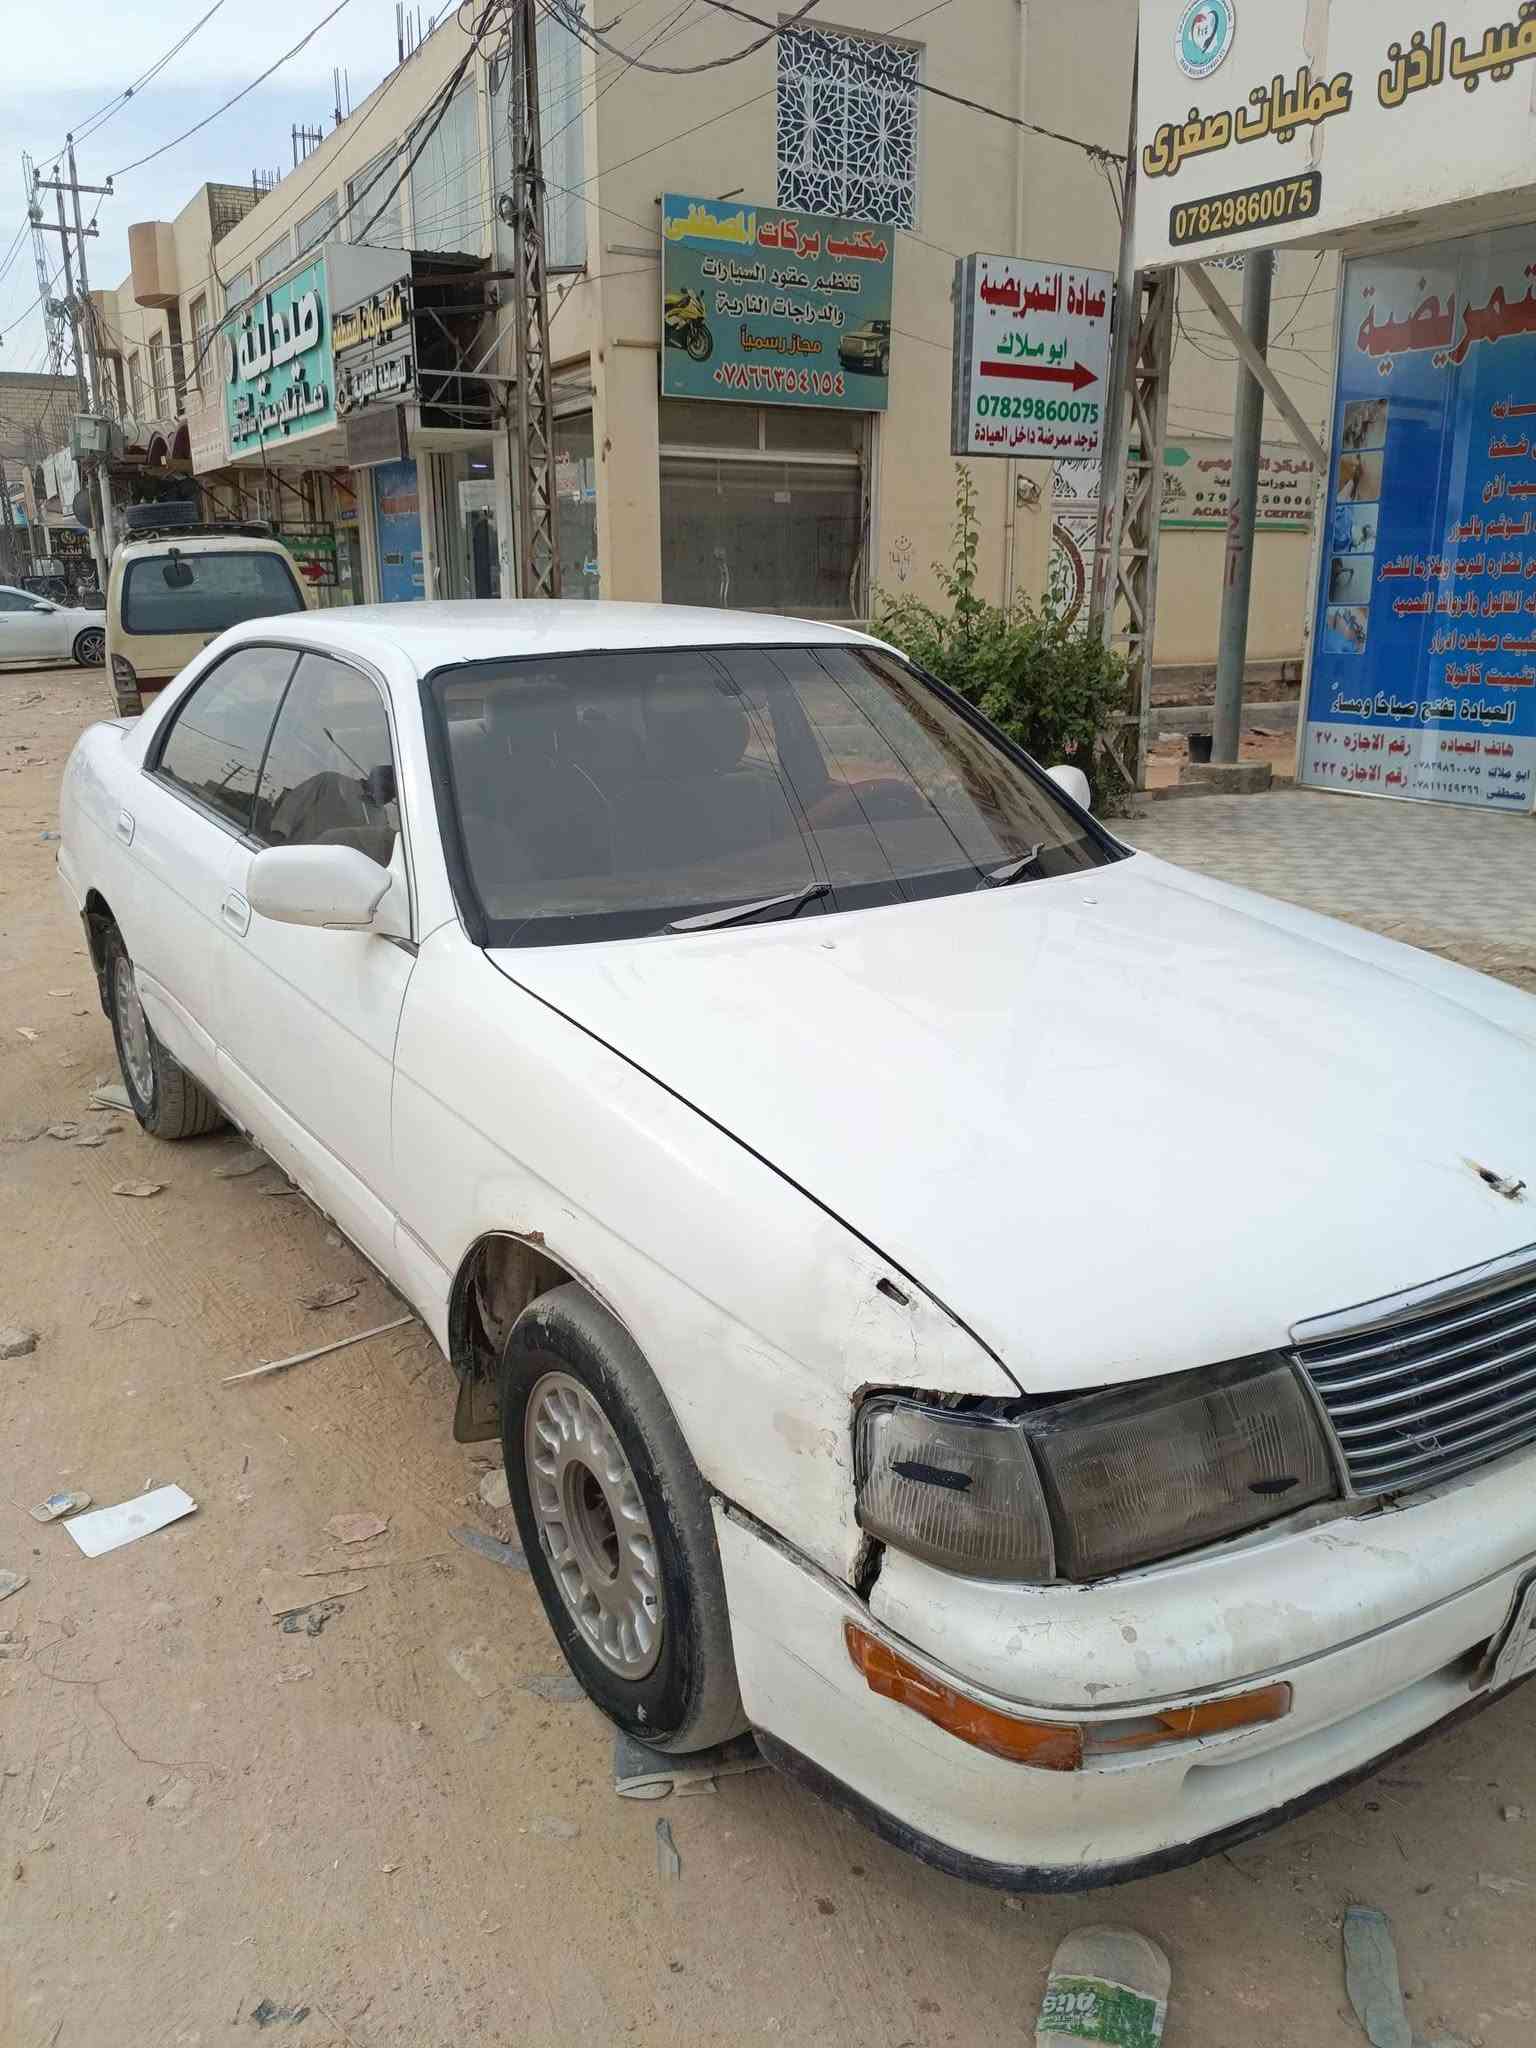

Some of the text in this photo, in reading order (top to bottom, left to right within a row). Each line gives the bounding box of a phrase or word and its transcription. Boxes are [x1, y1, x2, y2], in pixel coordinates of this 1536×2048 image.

[1234, 66, 1353, 143] عمليات
[1143, 107, 1232, 177] صغرى
[1175, 179, 1312, 239] 07829860075
[757, 219, 820, 261] بركات
[826, 231, 888, 263] مكتب
[702, 256, 861, 296] تنظيم عقود السيارات
[715, 293, 845, 326] والدراجات النارية
[980, 261, 1105, 328] عيادة التمريضية
[789, 334, 822, 356] مجاز
[996, 331, 1067, 365] ابو ملاك
[977, 394, 1099, 424] 07829860075
[974, 422, 1098, 452] توجد ممرضة داخل العيادة
[1420, 697, 1457, 724] تفتح
[1460, 698, 1517, 727] العيادة
[1388, 735, 1411, 758] رقم
[1385, 766, 1408, 789] رقم
